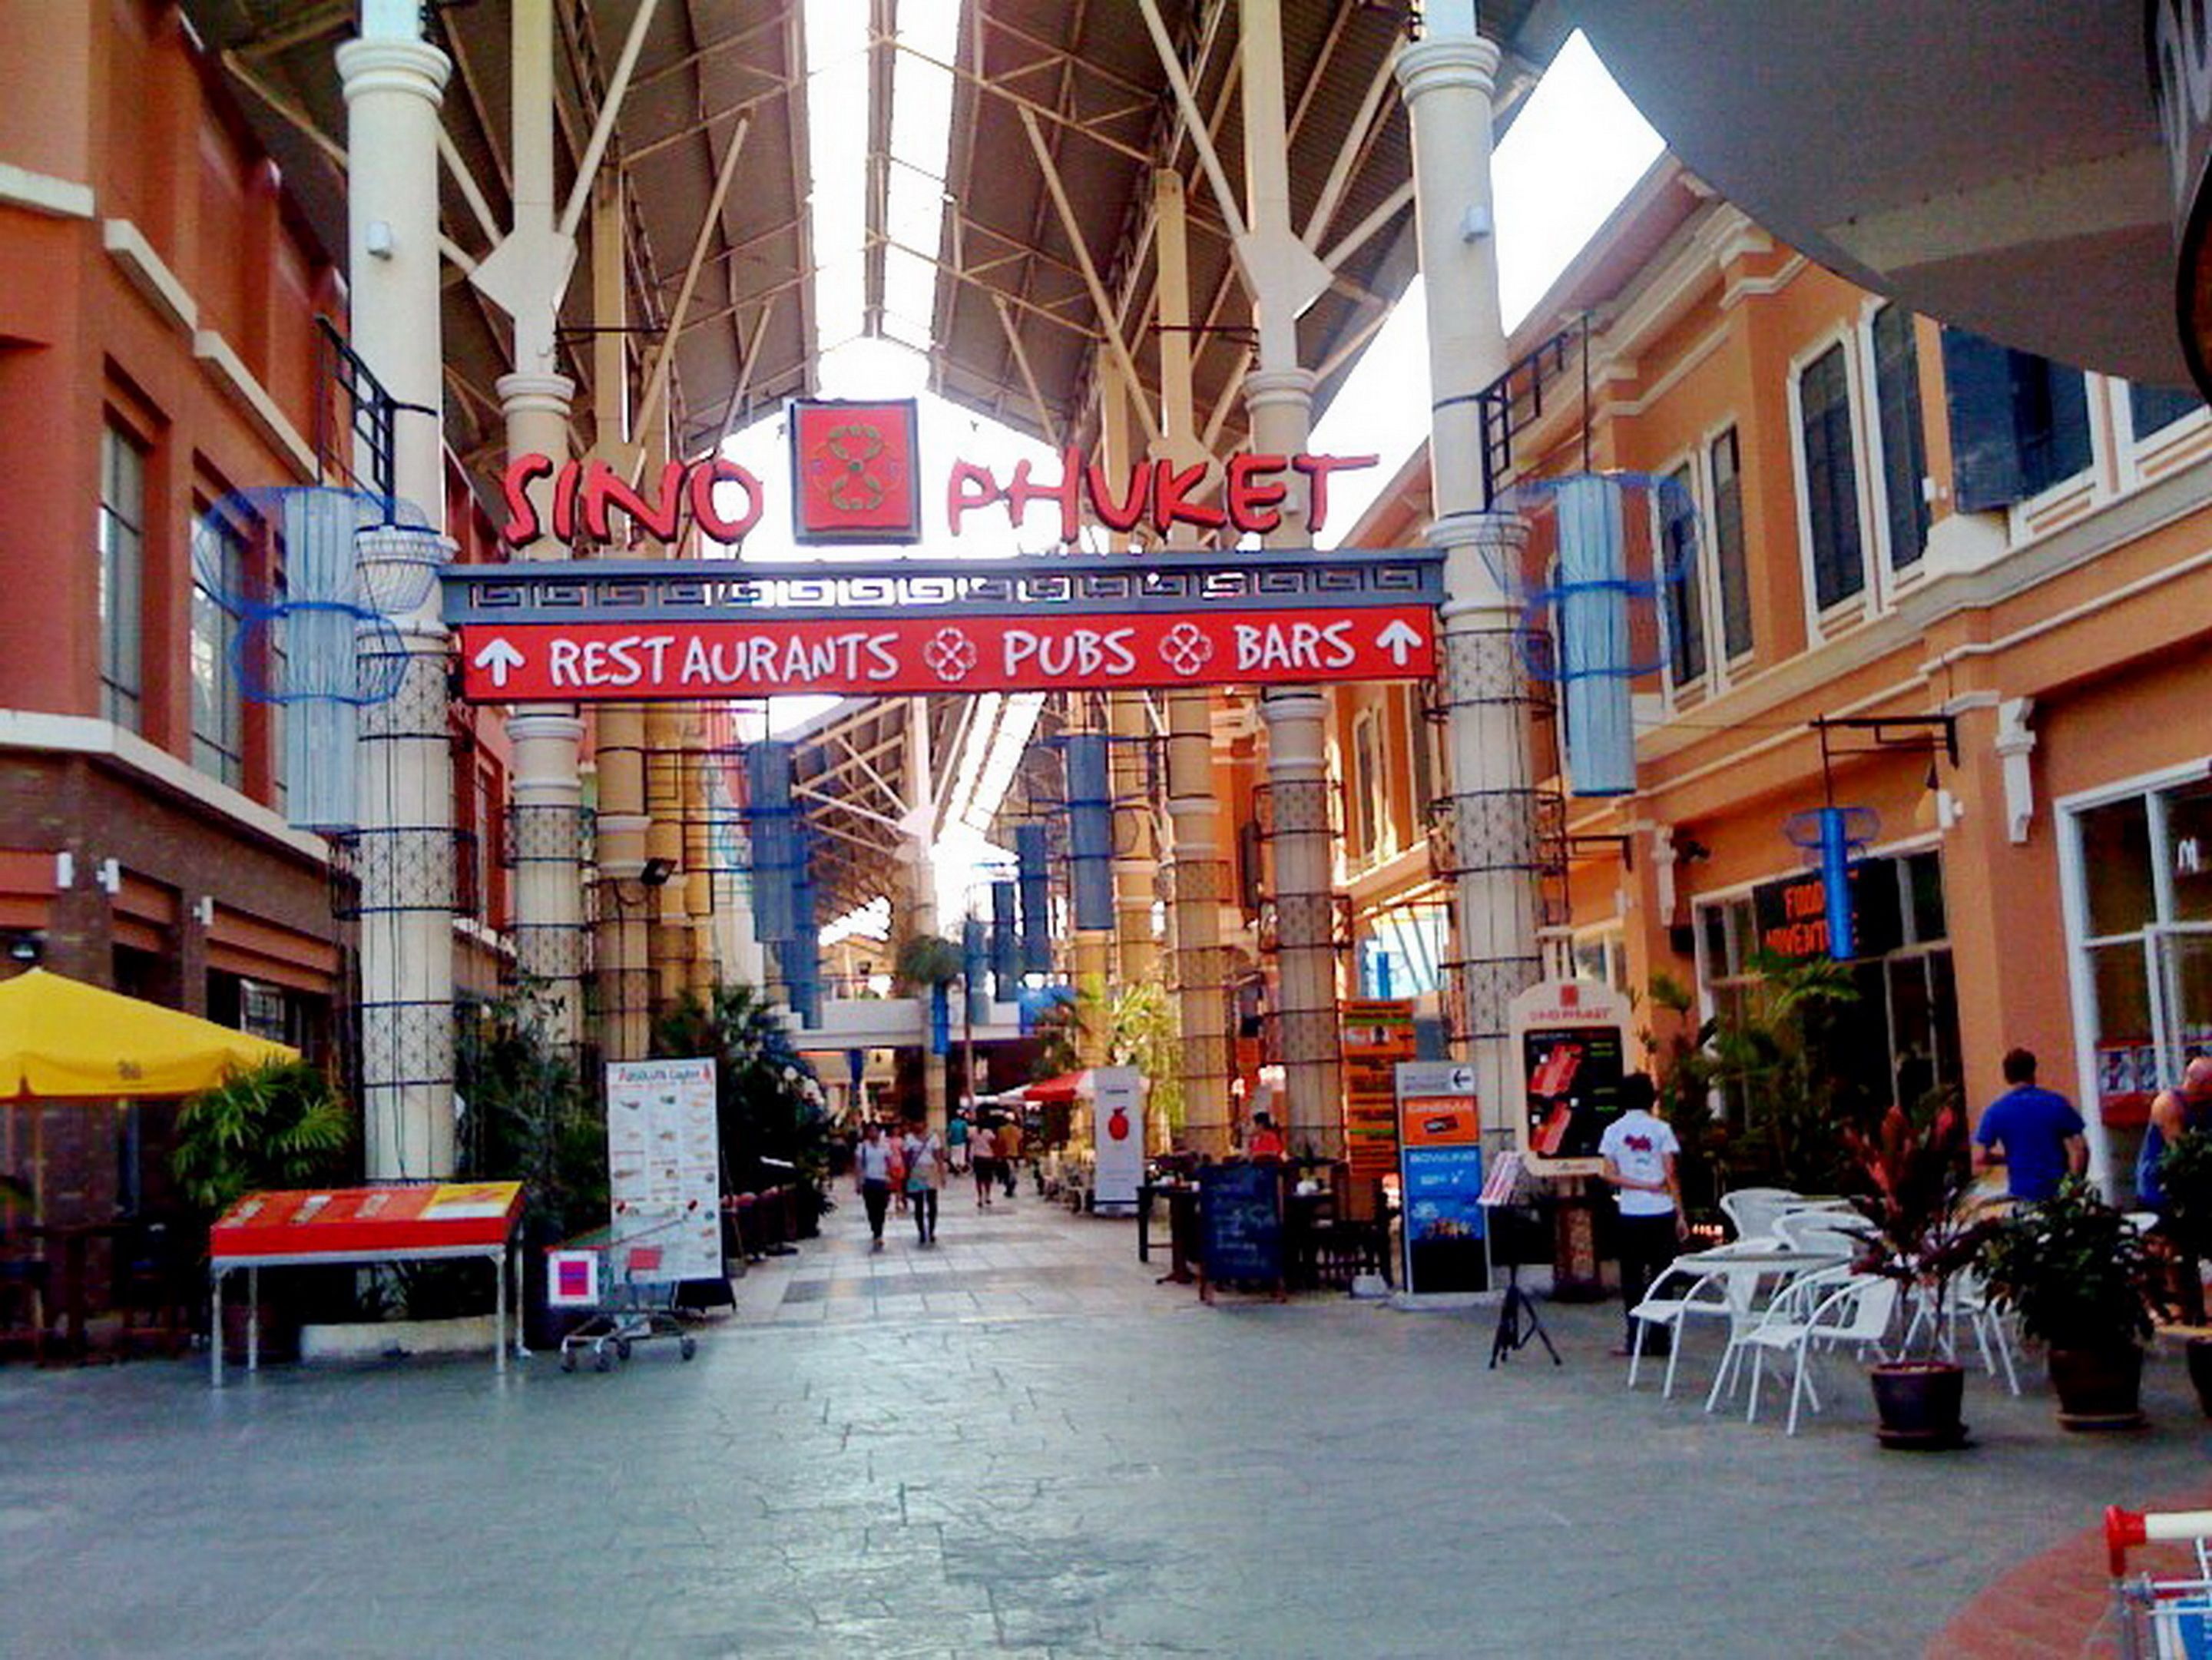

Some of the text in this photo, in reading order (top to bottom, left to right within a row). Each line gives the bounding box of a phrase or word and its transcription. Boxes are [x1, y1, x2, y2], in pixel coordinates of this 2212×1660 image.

[502, 446, 1380, 547] SINO PHUKET
[549, 619, 1356, 687] RESTAURANTS PUBS BARS
